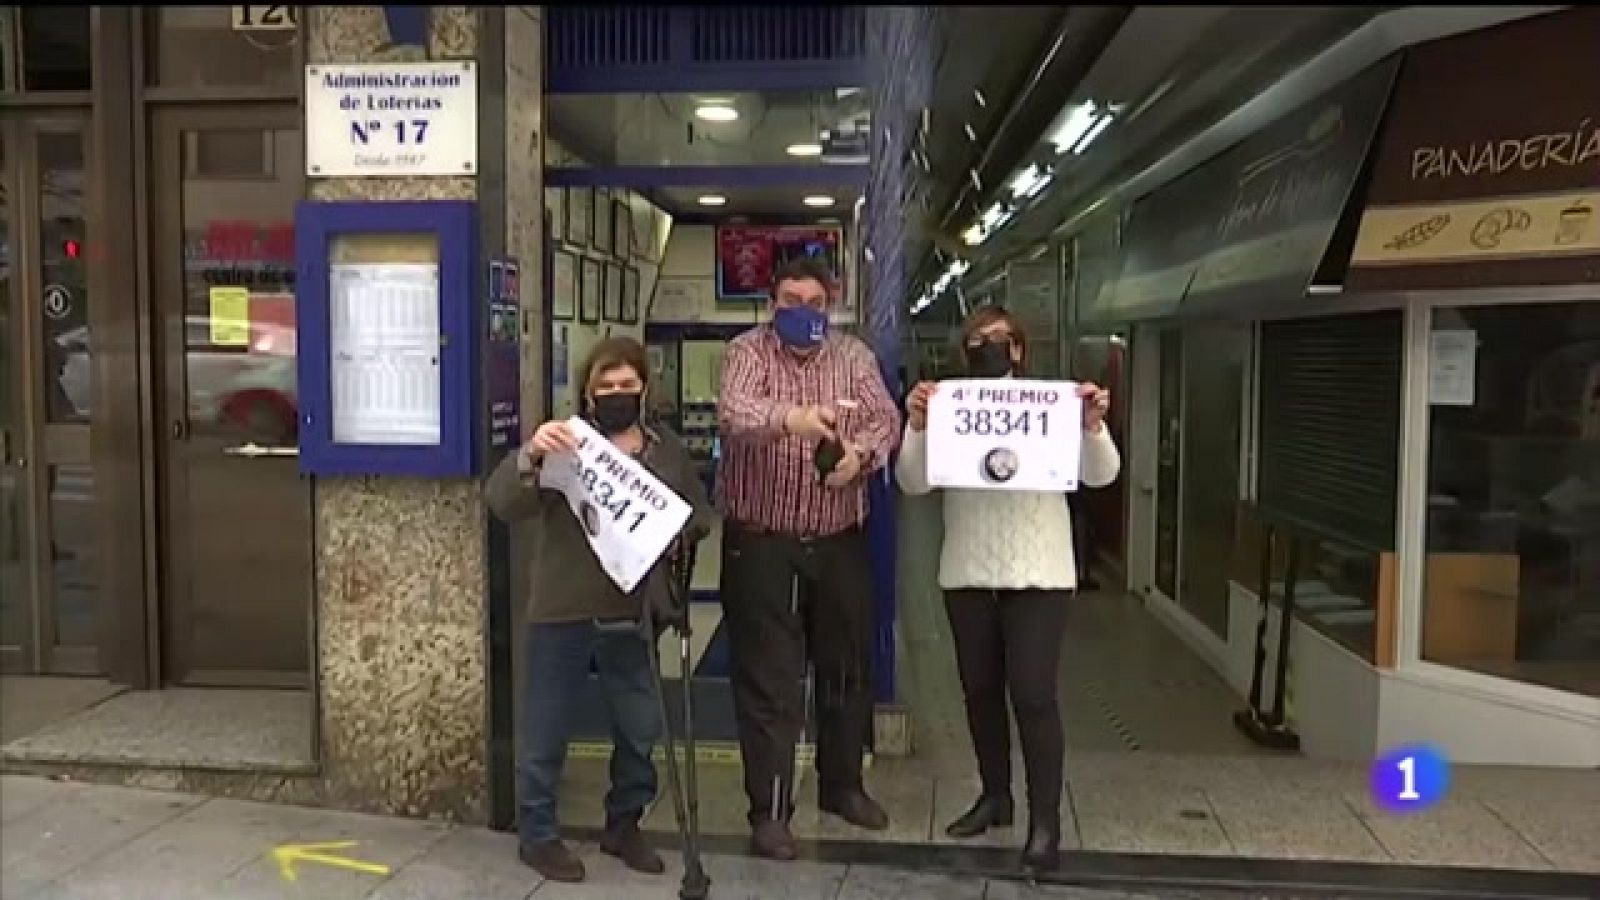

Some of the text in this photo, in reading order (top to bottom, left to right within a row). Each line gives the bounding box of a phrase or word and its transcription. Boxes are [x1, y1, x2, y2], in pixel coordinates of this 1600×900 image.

[323, 71, 460, 88] Administración
[339, 94, 361, 110] de
[350, 119, 429, 145] Nº 17
[1411, 116, 1600, 180] PANADERÍA
[979, 387, 1060, 405] PREMIO
[954, 407, 1048, 438] 38341
